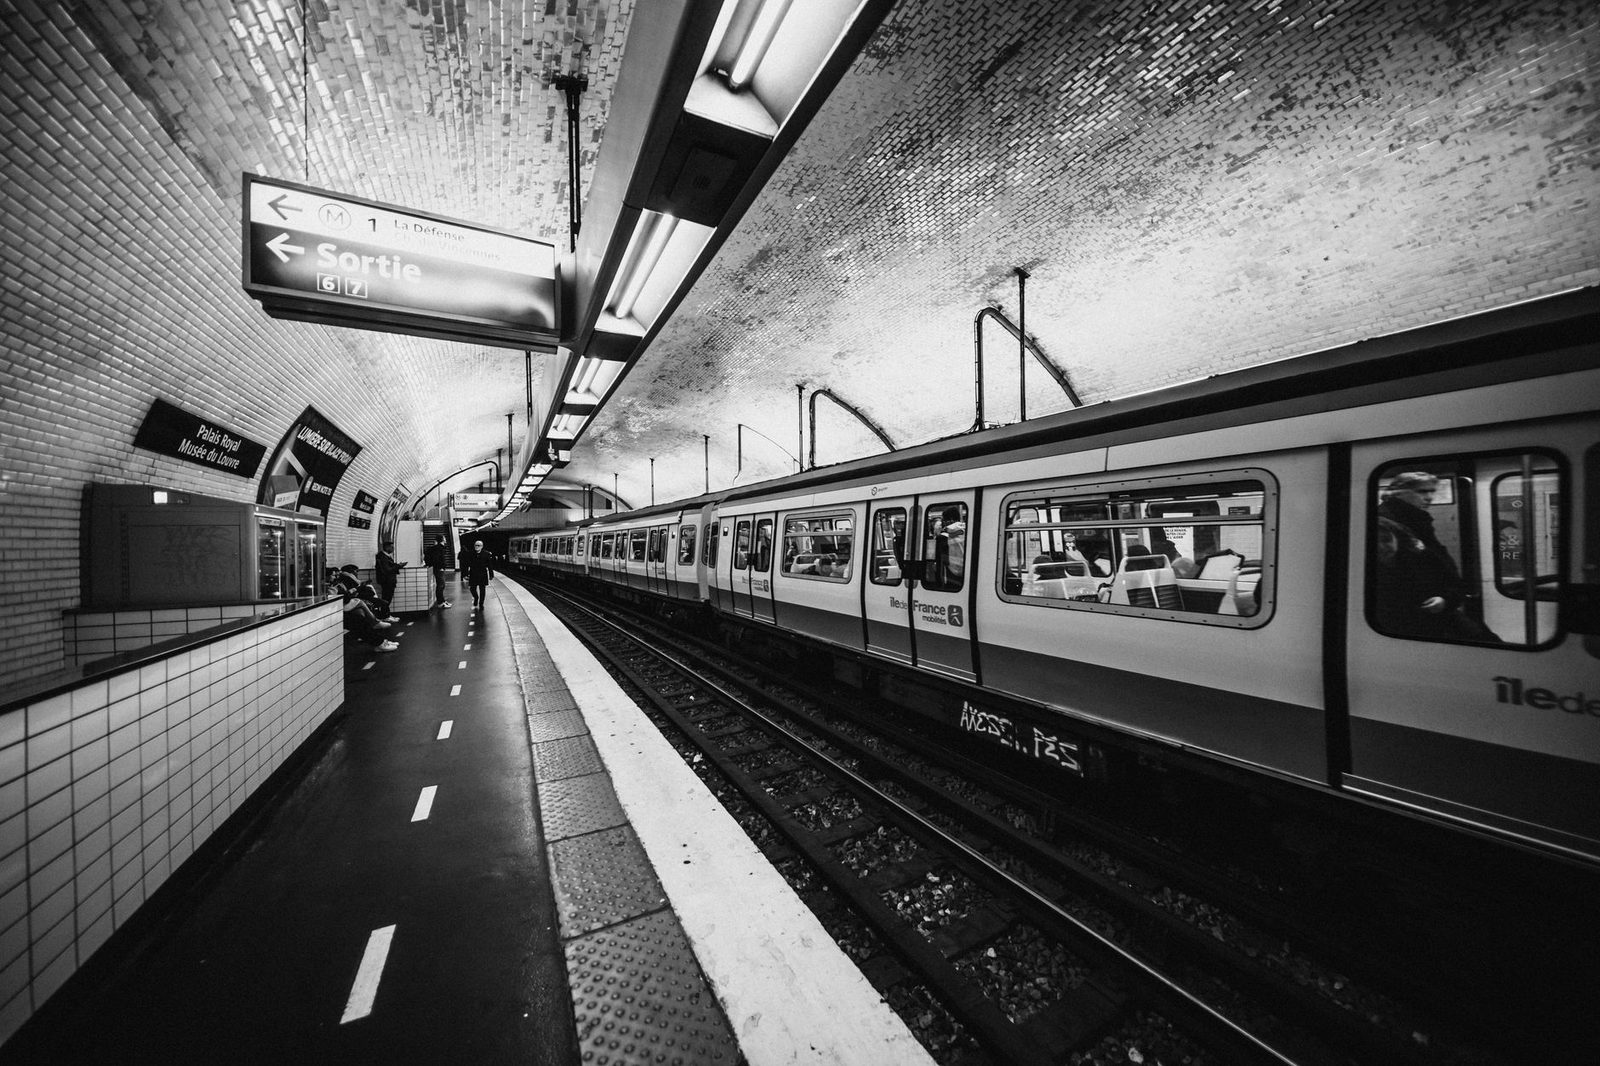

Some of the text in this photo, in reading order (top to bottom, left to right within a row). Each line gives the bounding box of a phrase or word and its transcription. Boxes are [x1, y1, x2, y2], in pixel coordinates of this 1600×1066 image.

[368, 218, 376, 232] 1
[394, 219, 409, 231] La
[413, 222, 465, 241] Défense
[317, 242, 422, 283] Sortie
[196, 424, 242, 452] Palais Royal
[178, 438, 240, 469] Musée du Louvre
[913, 599, 946, 616] France
